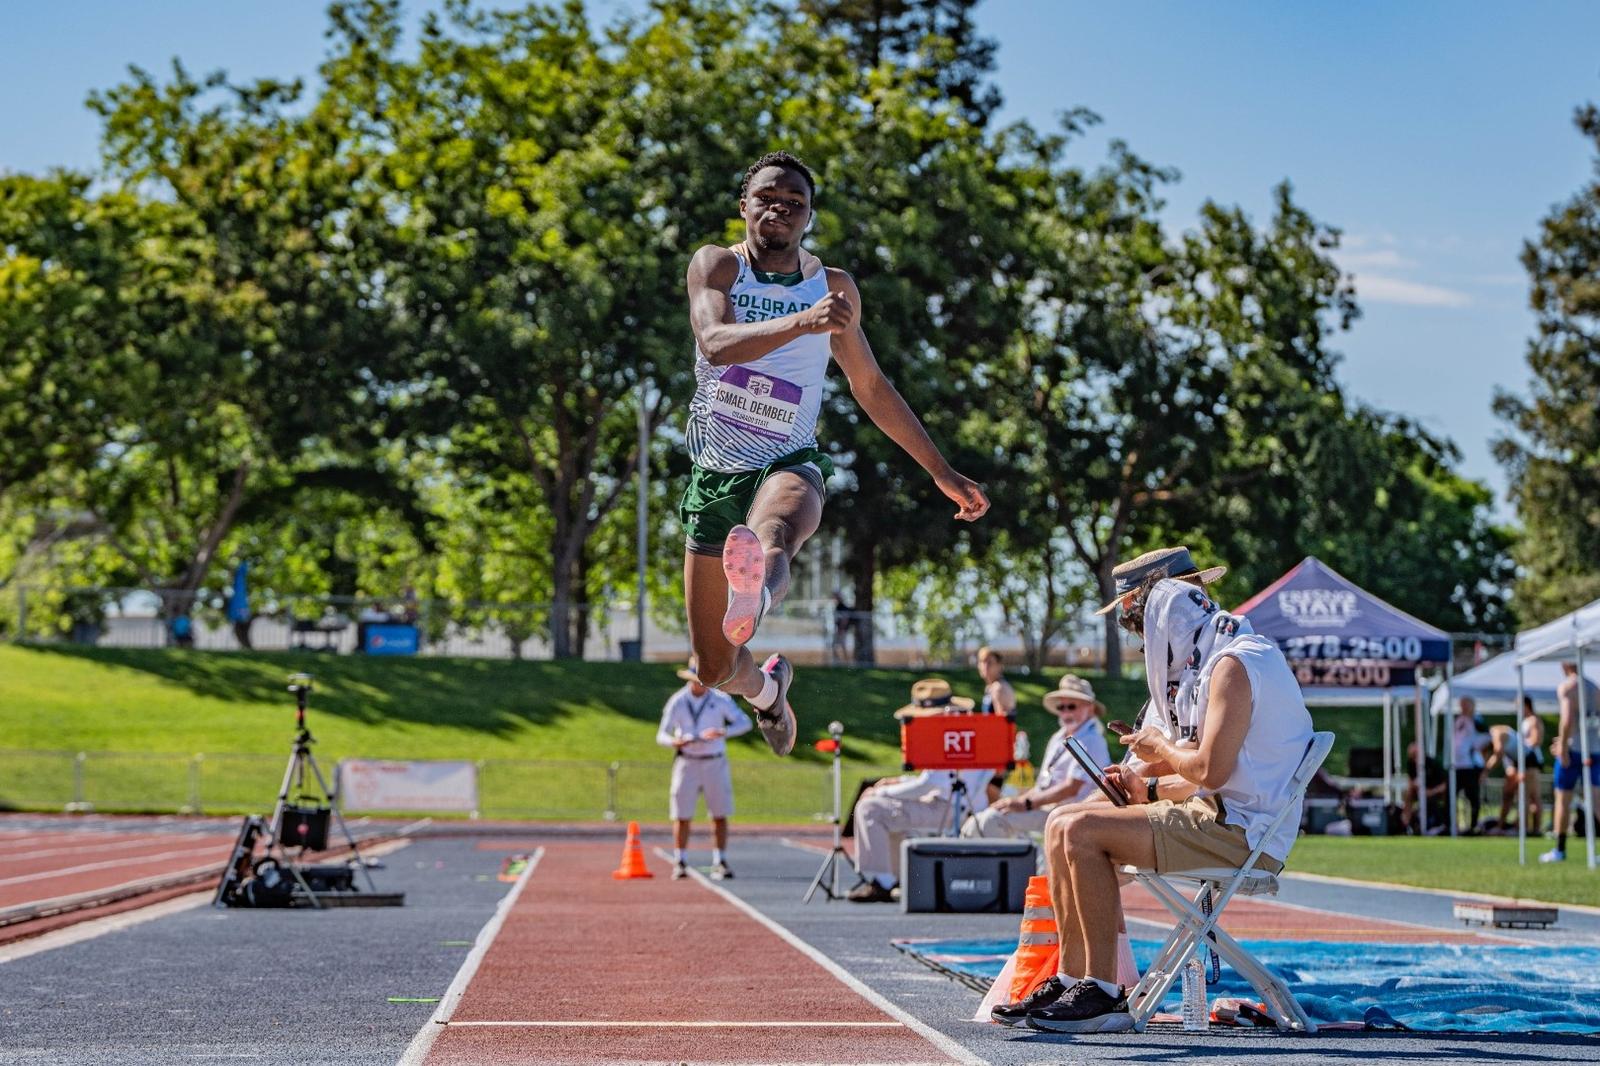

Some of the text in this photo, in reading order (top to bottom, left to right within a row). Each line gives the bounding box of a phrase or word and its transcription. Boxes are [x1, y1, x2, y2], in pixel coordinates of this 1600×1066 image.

[730, 293, 813, 314] COLORAD
[750, 380, 770, 393] 25
[715, 388, 795, 424] ISMAEL DEMBELE
[732, 411, 755, 424] COLORADO
[754, 418, 769, 428] STATE
[1280, 600, 1357, 617] STATE
[944, 731, 976, 752] RT
